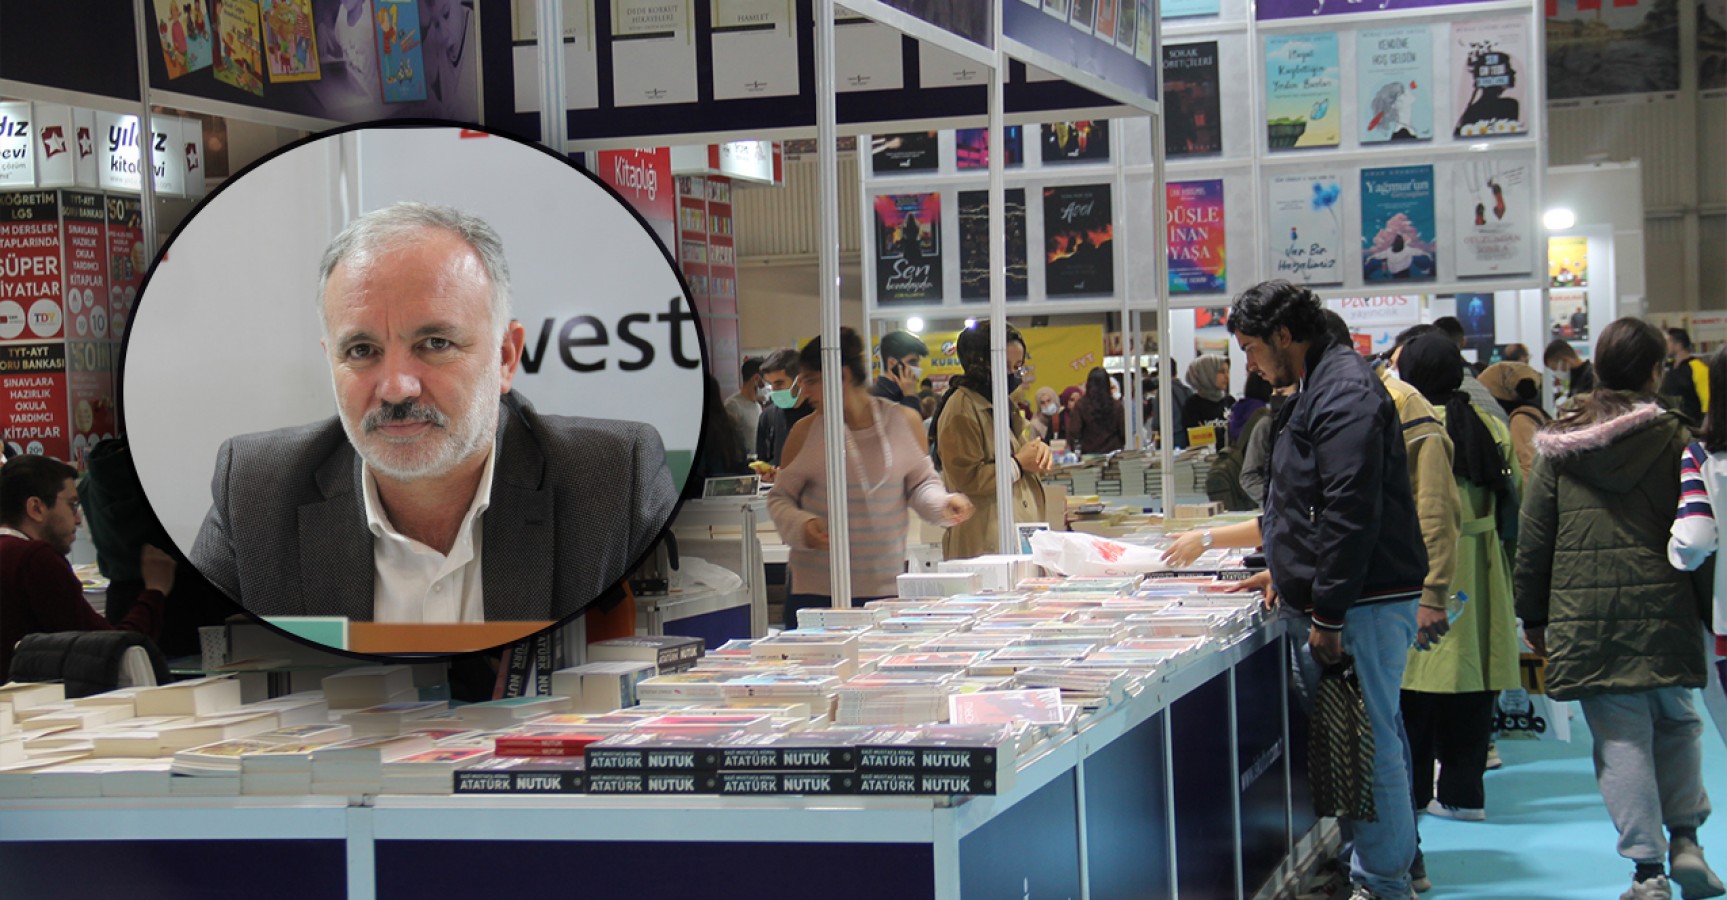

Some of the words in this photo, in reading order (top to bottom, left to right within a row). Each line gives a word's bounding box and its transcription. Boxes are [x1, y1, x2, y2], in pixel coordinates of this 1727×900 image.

[737, 13, 769, 22] HAMLET
[1169, 48, 1198, 58] SOKAK
[12, 208, 33, 219] LGS
[1170, 225, 1209, 242] İNAN
[1170, 244, 1211, 261] YAŞA
[92, 313, 105, 331] 10
[8, 347, 49, 357] TYT-AYT
[22, 358, 65, 369] BANKASI
[3, 377, 54, 388] SINAVLARA
[10, 389, 51, 400] HAZIRLIK
[15, 401, 47, 411] OKULA
[9, 413, 53, 423] YARDIMCI
[3, 425, 60, 439] KİTAPLAR
[590, 756, 642, 768] ATATÜRK
[648, 755, 694, 767] NUTUK
[724, 755, 777, 766] ATATÜRK
[783, 752, 830, 765] NUTUK
[861, 755, 915, 767] ATATÜRK
[922, 754, 971, 767] NUTUK
[460, 778, 511, 790] ATATÜRK
[516, 777, 561, 790] NUTUK
[590, 780, 642, 791] ATATÜRK
[648, 779, 694, 791] NUTUK
[724, 780, 777, 792] ATATÜRK
[783, 778, 831, 791] NUTUK
[861, 779, 915, 791] ATATÜRK
[922, 779, 971, 792] NUTUK
